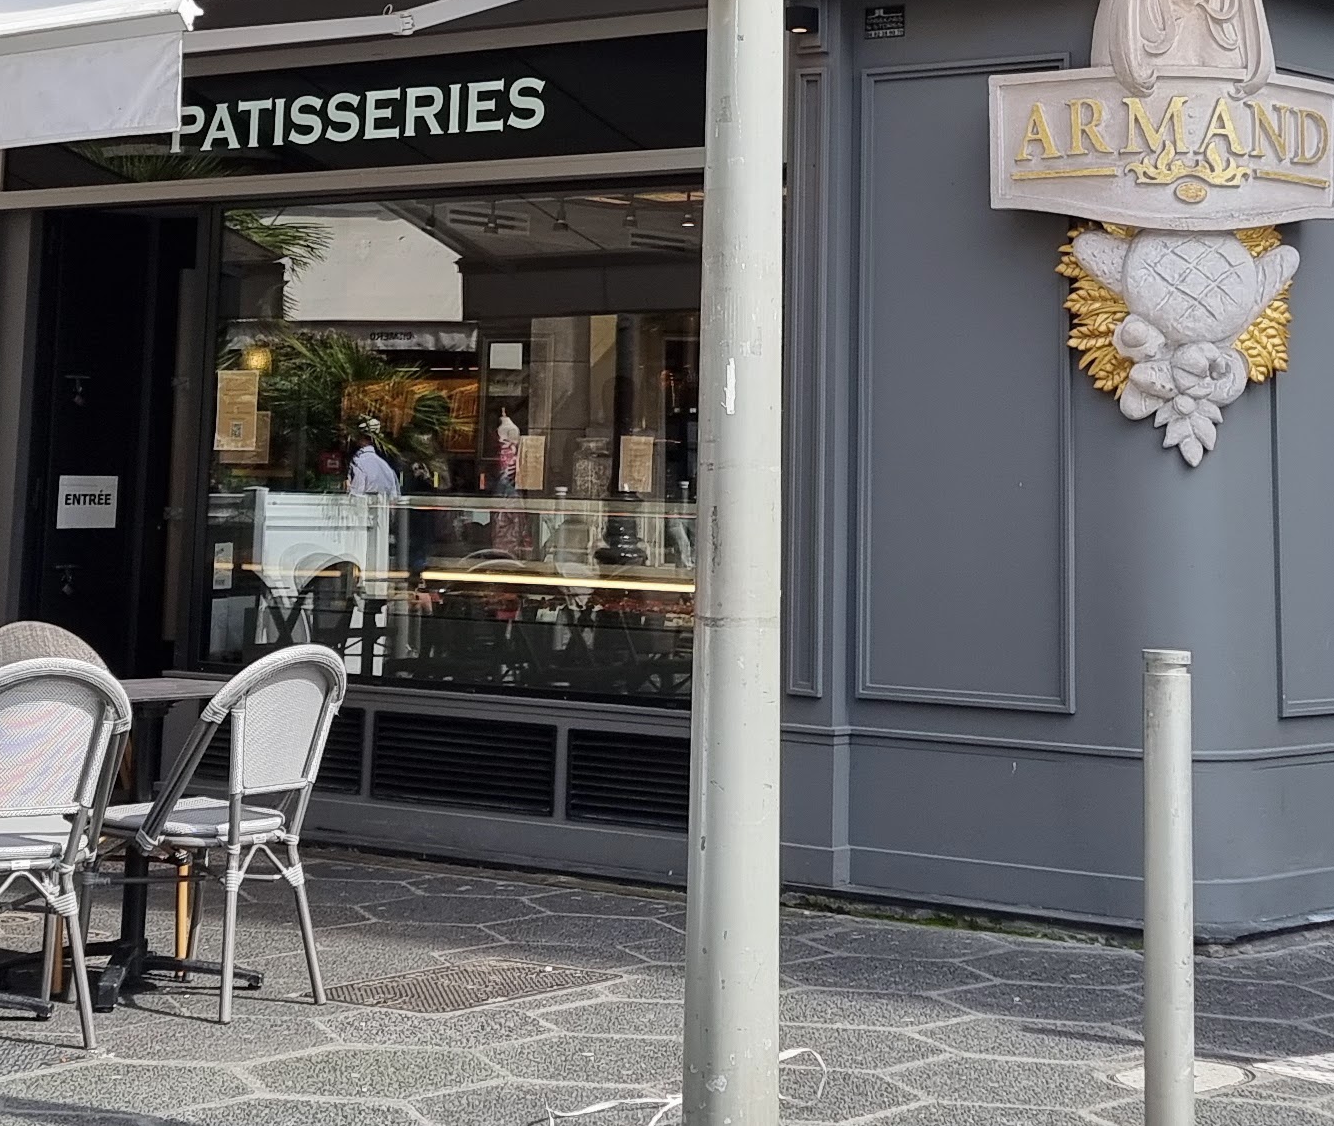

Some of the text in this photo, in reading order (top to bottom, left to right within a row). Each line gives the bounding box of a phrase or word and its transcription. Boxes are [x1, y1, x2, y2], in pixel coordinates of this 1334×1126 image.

[169, 77, 546, 153] PATISSERIES
[1014, 96, 1330, 164] ARMAND
[65, 489, 112, 506] ENTRÉE
